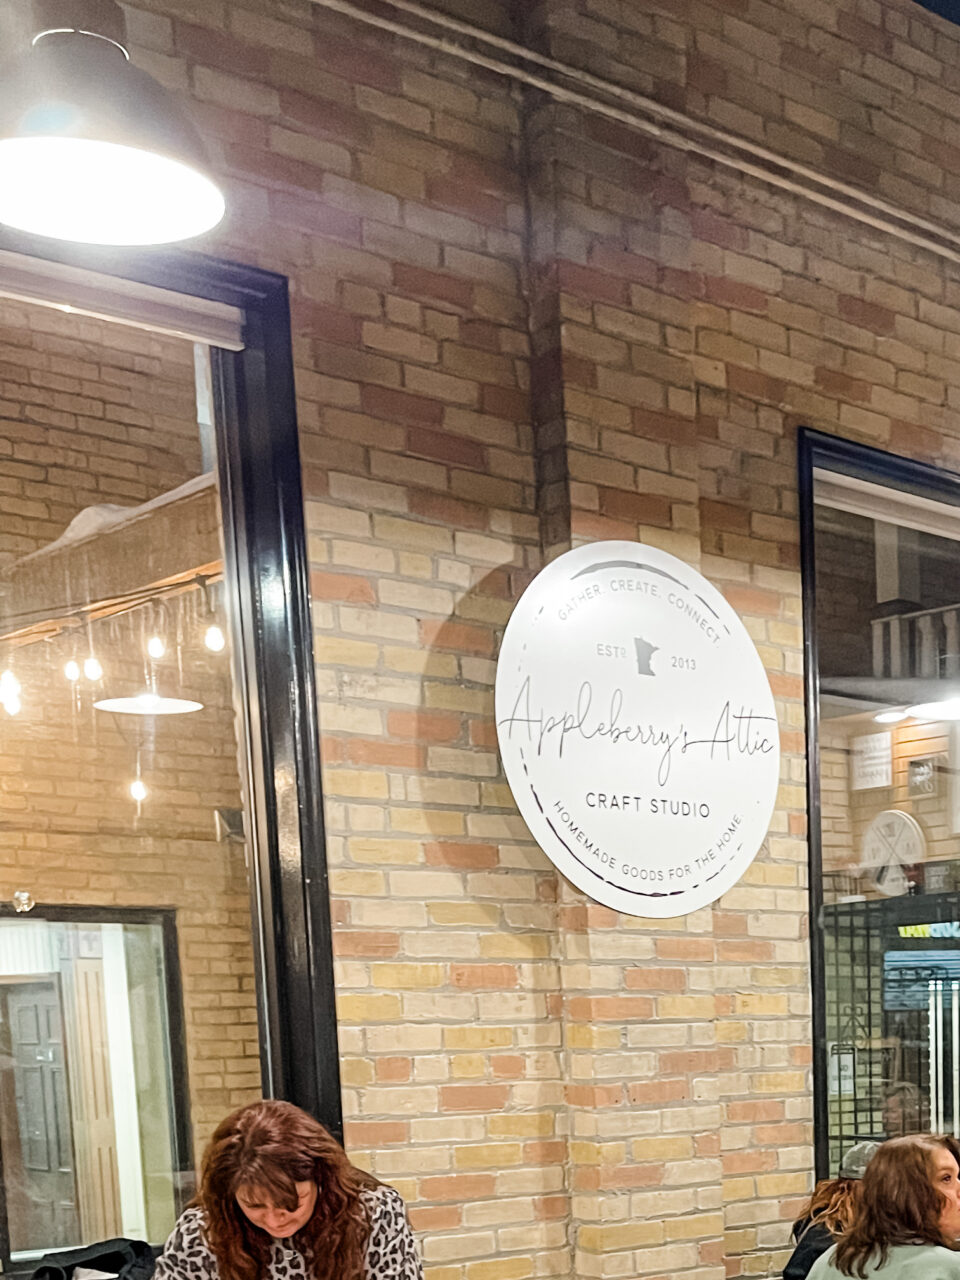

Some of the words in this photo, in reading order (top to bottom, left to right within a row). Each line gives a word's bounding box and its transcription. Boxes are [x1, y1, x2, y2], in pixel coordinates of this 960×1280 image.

[671, 656, 697, 670] 2013
[498, 676, 689, 786] Appleberry's
[692, 700, 777, 761] Attic
[585, 792, 641, 812] CRAFT
[650, 798, 710, 818] STUDIO
[553, 800, 617, 869] HOMEMADE
[621, 864, 664, 881] GOODS
[669, 864, 692, 880] FOR
[695, 848, 718, 870] THE
